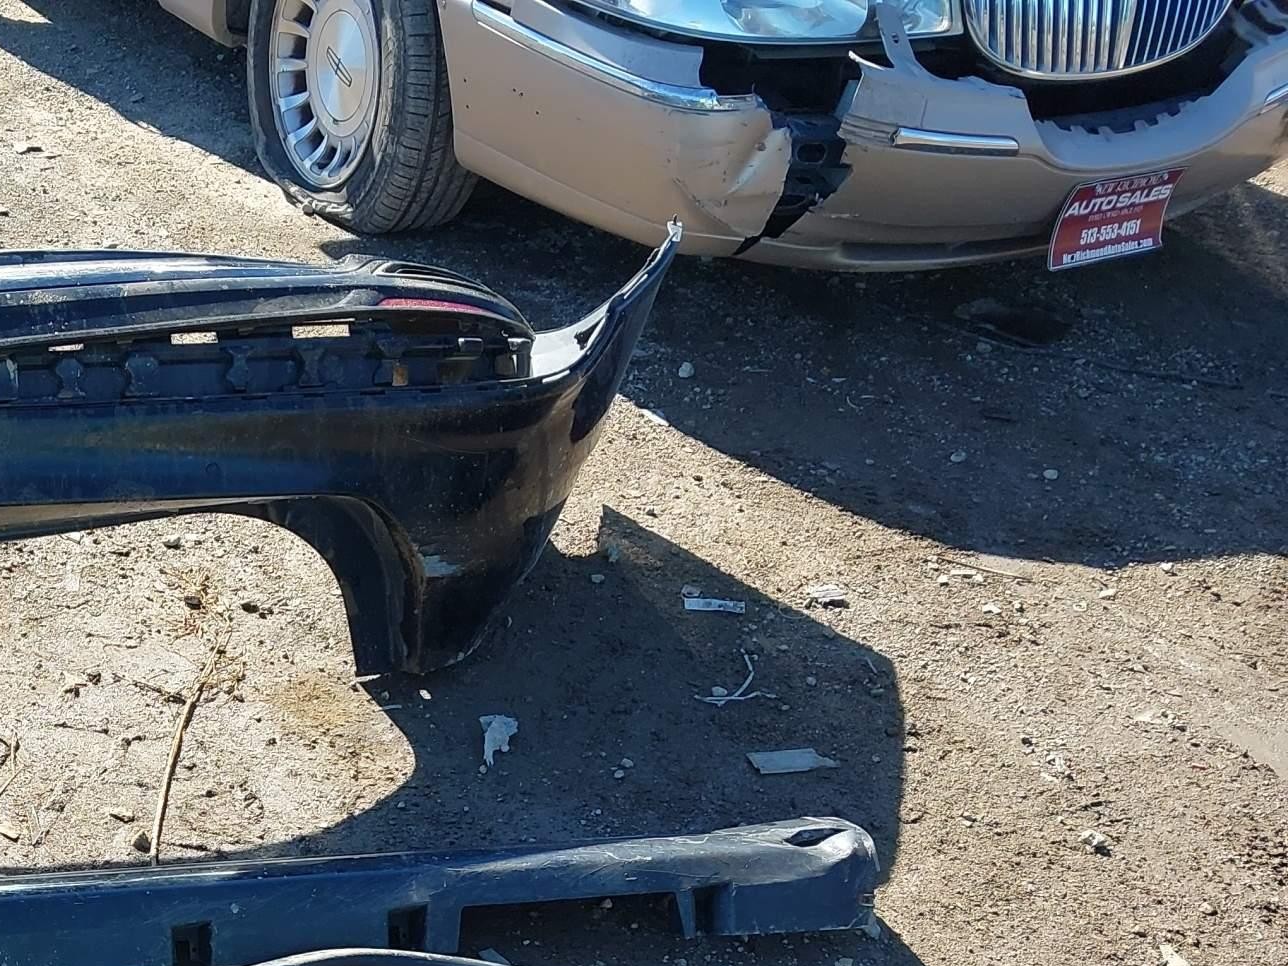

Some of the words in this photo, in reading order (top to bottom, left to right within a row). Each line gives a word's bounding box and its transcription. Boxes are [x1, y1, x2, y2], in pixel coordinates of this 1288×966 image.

[1064, 195, 1118, 217] AUTO
[1116, 184, 1173, 207] SALES
[1080, 218, 1142, 246] 513-553-4151
